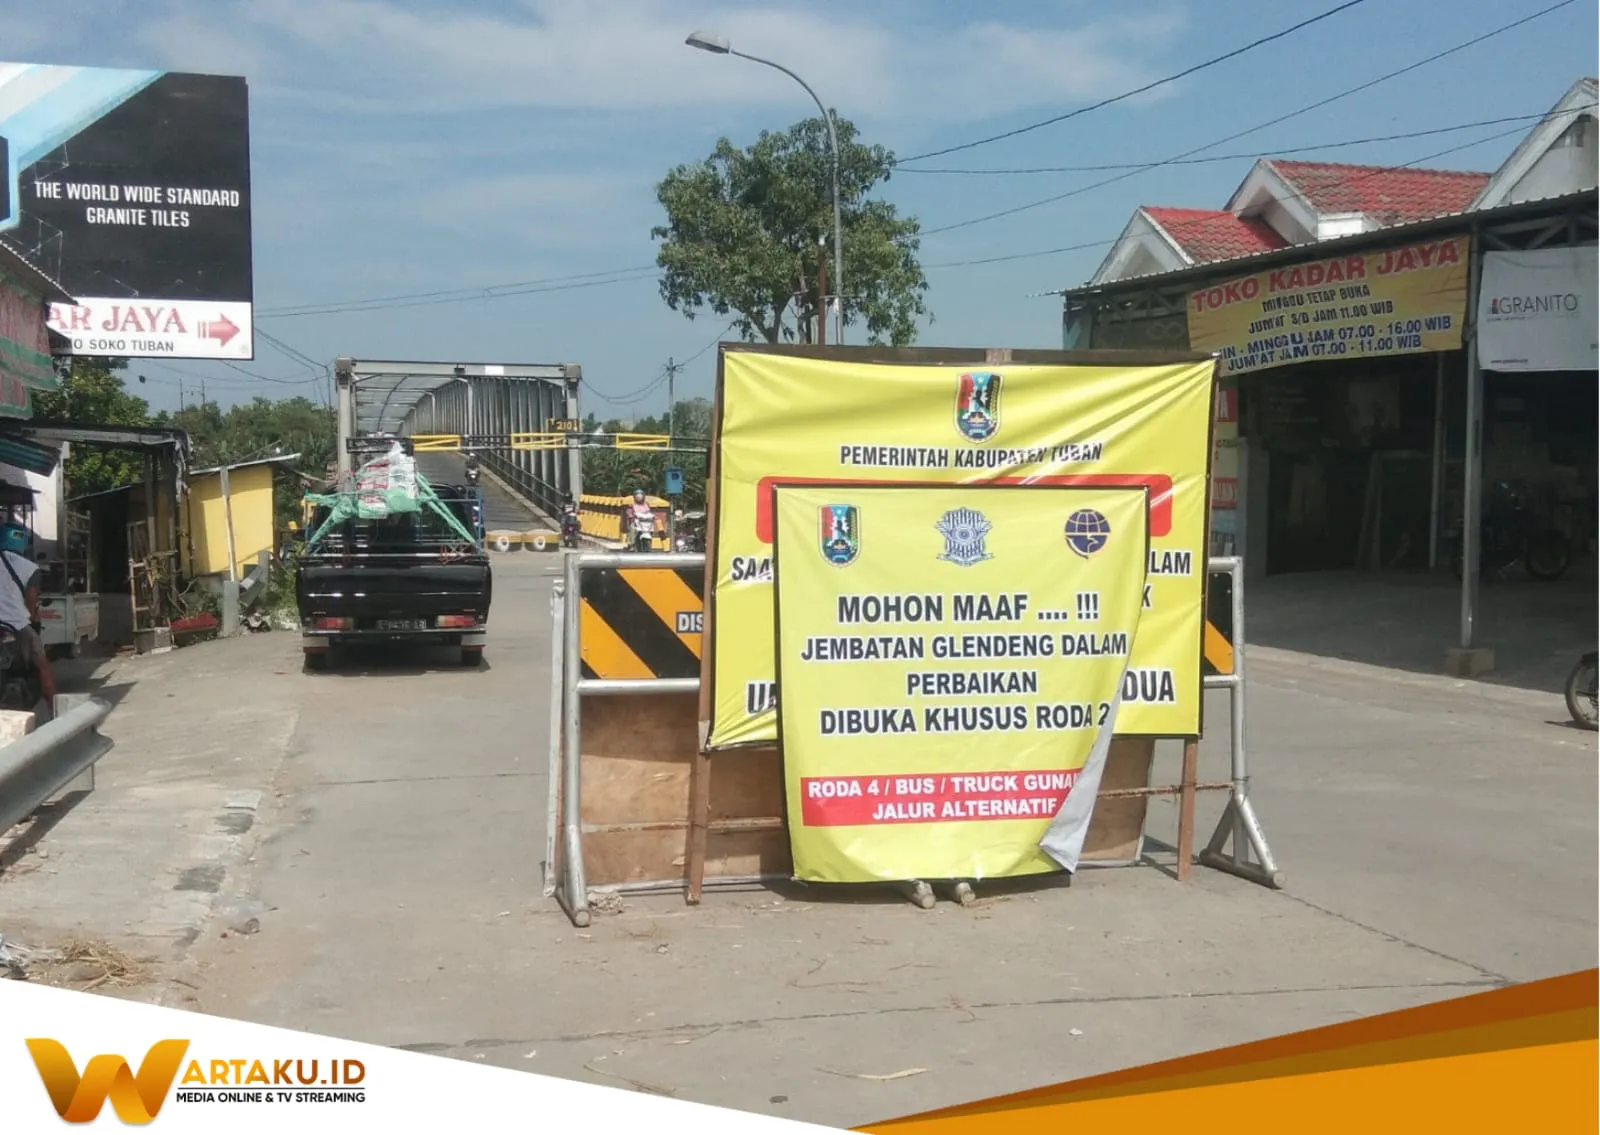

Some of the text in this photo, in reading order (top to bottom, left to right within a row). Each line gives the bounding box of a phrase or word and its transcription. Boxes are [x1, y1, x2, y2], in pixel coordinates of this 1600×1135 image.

[34, 181, 240, 208] THE WORLD WIDE STANDARD
[86, 207, 190, 228] GRANITE TILES
[1192, 240, 1460, 312] TOKO KADAR JAYA
[1307, 289, 1336, 304] TETAP
[1339, 285, 1370, 300] BUKA
[1500, 293, 1578, 314] GRANITO
[102, 306, 188, 333] JAYA
[1313, 309, 1338, 322] JAM
[1340, 304, 1368, 319] 11.00
[1370, 301, 1393, 315] WIB
[89, 339, 126, 350] SOKO
[131, 340, 174, 352] TUBAN
[1247, 332, 1303, 354] MINGGU
[1307, 328, 1334, 343] JAM
[1338, 324, 1375, 340] 07.00
[1387, 319, 1422, 335] 16.00
[1425, 315, 1452, 331] WIB
[1279, 344, 1309, 361] JAM
[1312, 341, 1346, 357] 07.00
[1359, 336, 1393, 352] 11.00
[1396, 333, 1422, 348] WIB
[840, 443, 1103, 468] PEMERINTAH KABUPATEN TUBAN
[732, 551, 1190, 581] SAA LAM
[838, 595, 943, 623] MOHON
[953, 594, 1028, 621] MAAF
[1077, 593, 1099, 620] !!!
[678, 613, 703, 632] DIS
[801, 633, 1126, 660] JEMBATAN GLENDENG DALAM
[907, 671, 1037, 695] PERBAIKAN
[821, 703, 1110, 734] DIBUKA KHUSUS RODA 2
[808, 780, 863, 798] RODA
[867, 779, 879, 796] 4
[895, 778, 935, 795] BUS
[951, 776, 1018, 793] TRUCK
[872, 798, 1057, 820] JALUR ALTERNATIF
